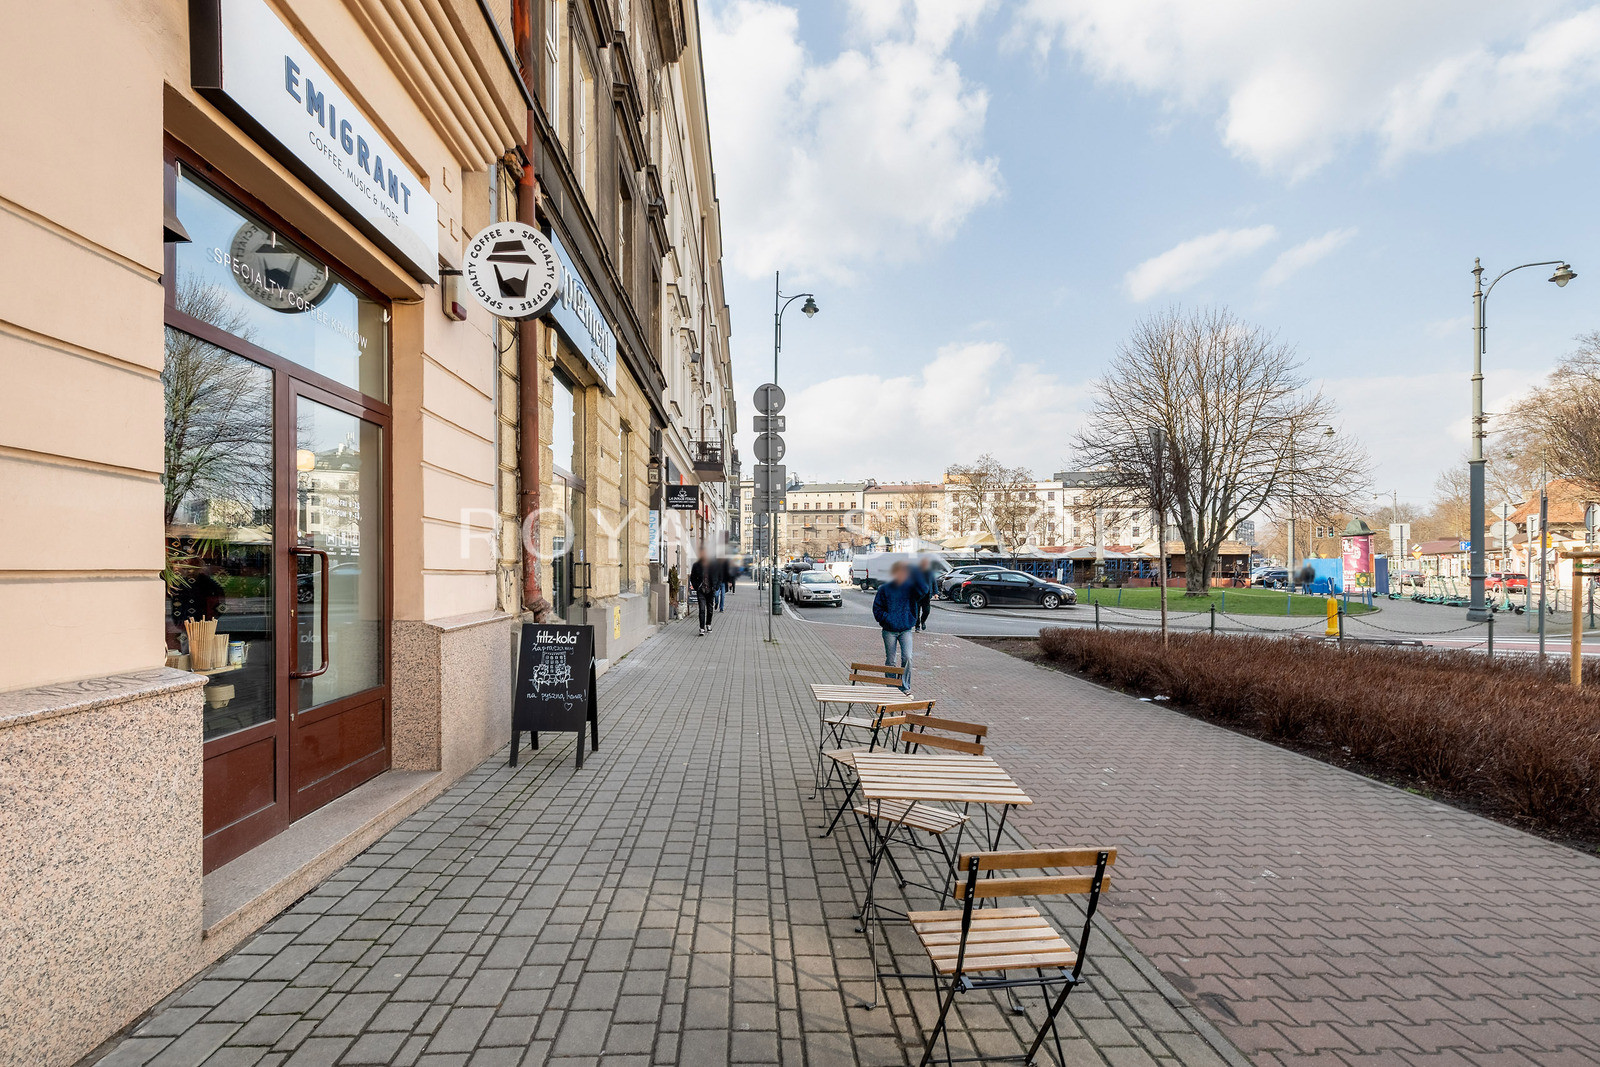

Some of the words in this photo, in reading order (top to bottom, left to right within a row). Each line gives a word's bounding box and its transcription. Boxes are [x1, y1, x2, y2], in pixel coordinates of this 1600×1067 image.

[285, 55, 411, 214] EMIGRANT
[309, 131, 345, 175] COFFEE,
[347, 168, 371, 199] MUSIC
[373, 194, 378, 205] &
[380, 202, 399, 226] MORE
[471, 229, 502, 259] COFFEE
[522, 230, 554, 279] SPECIALTY
[214, 247, 285, 298] SPECIALTY
[288, 291, 328, 325] COFFEE
[468, 262, 503, 310] SPECIALTY
[520, 282, 552, 311] COFFEE
